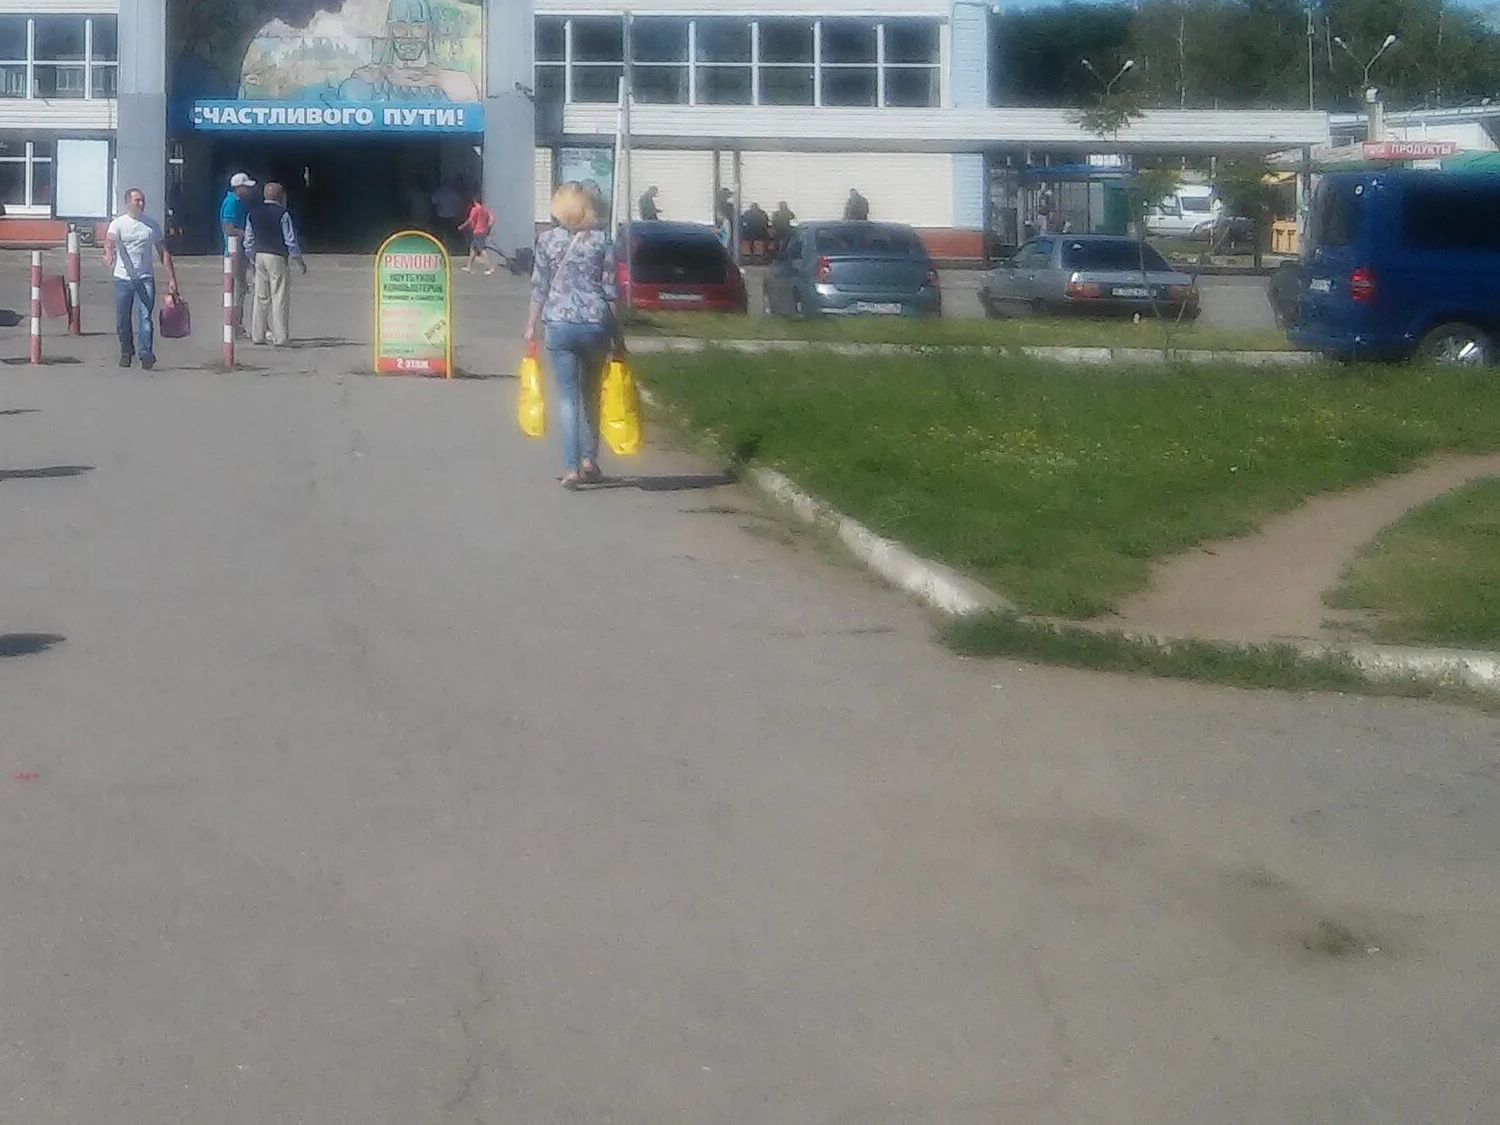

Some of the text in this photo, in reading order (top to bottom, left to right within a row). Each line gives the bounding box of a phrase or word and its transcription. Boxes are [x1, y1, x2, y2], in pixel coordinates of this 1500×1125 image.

[190, 107, 464, 126] СЧАСТЛИВОГО ПУТИ!
[1391, 143, 1452, 155] ПРОДУКТЫ
[384, 255, 440, 269] РЕМОНТ
[396, 358, 403, 368] 2
